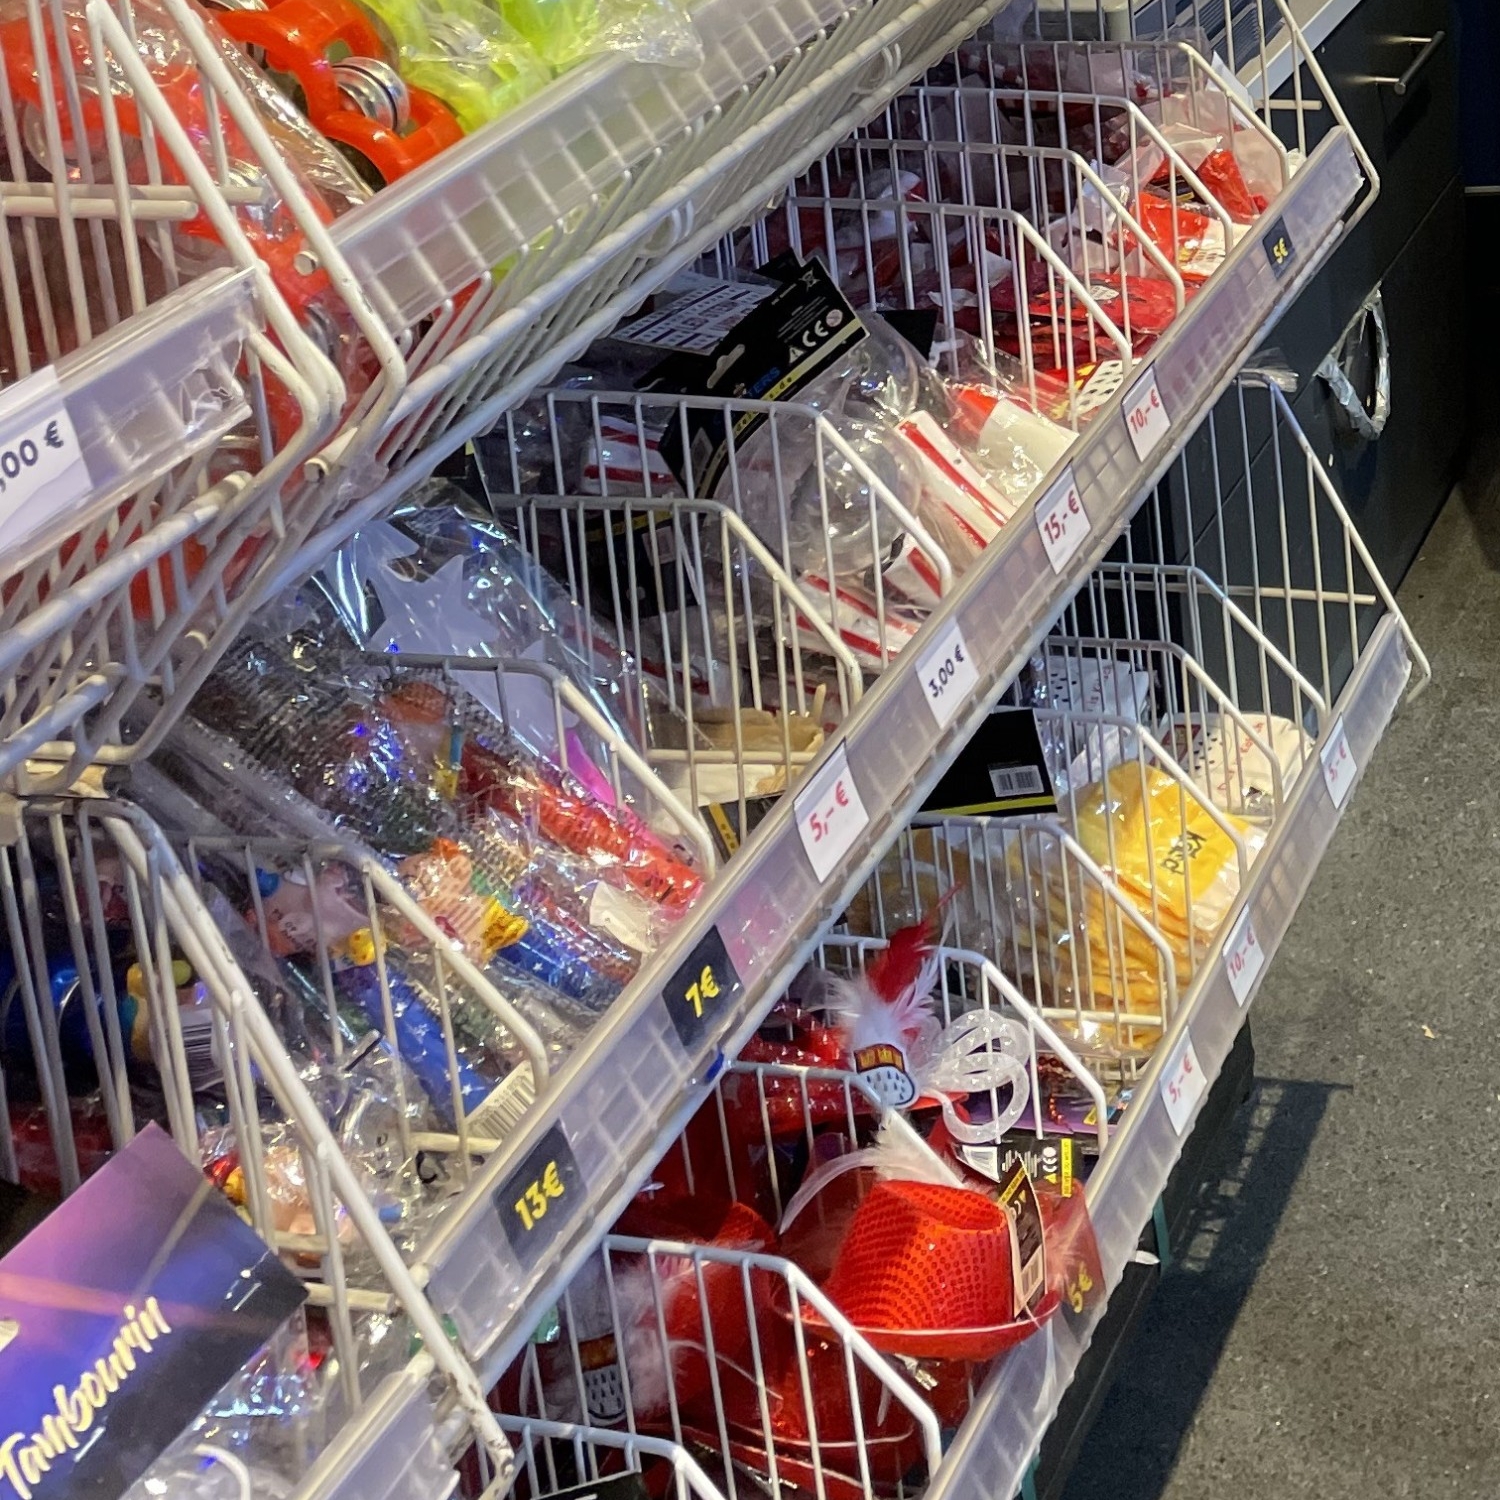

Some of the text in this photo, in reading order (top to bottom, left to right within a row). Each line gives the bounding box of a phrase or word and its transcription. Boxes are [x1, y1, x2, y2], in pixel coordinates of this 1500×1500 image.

[1273, 237, 1289, 264] 5€
[1150, 389, 1160, 408] €
[44, 420, 64, 449] €
[1067, 490, 1080, 514] €
[928, 644, 965, 698] 3,00 €
[835, 781, 849, 807] €
[1246, 929, 1255, 947] €
[685, 965, 720, 1018] 7€
[1182, 1054, 1194, 1074] €
[514, 1161, 565, 1231] 13€
[0, 1296, 172, 1500] Tambourin
